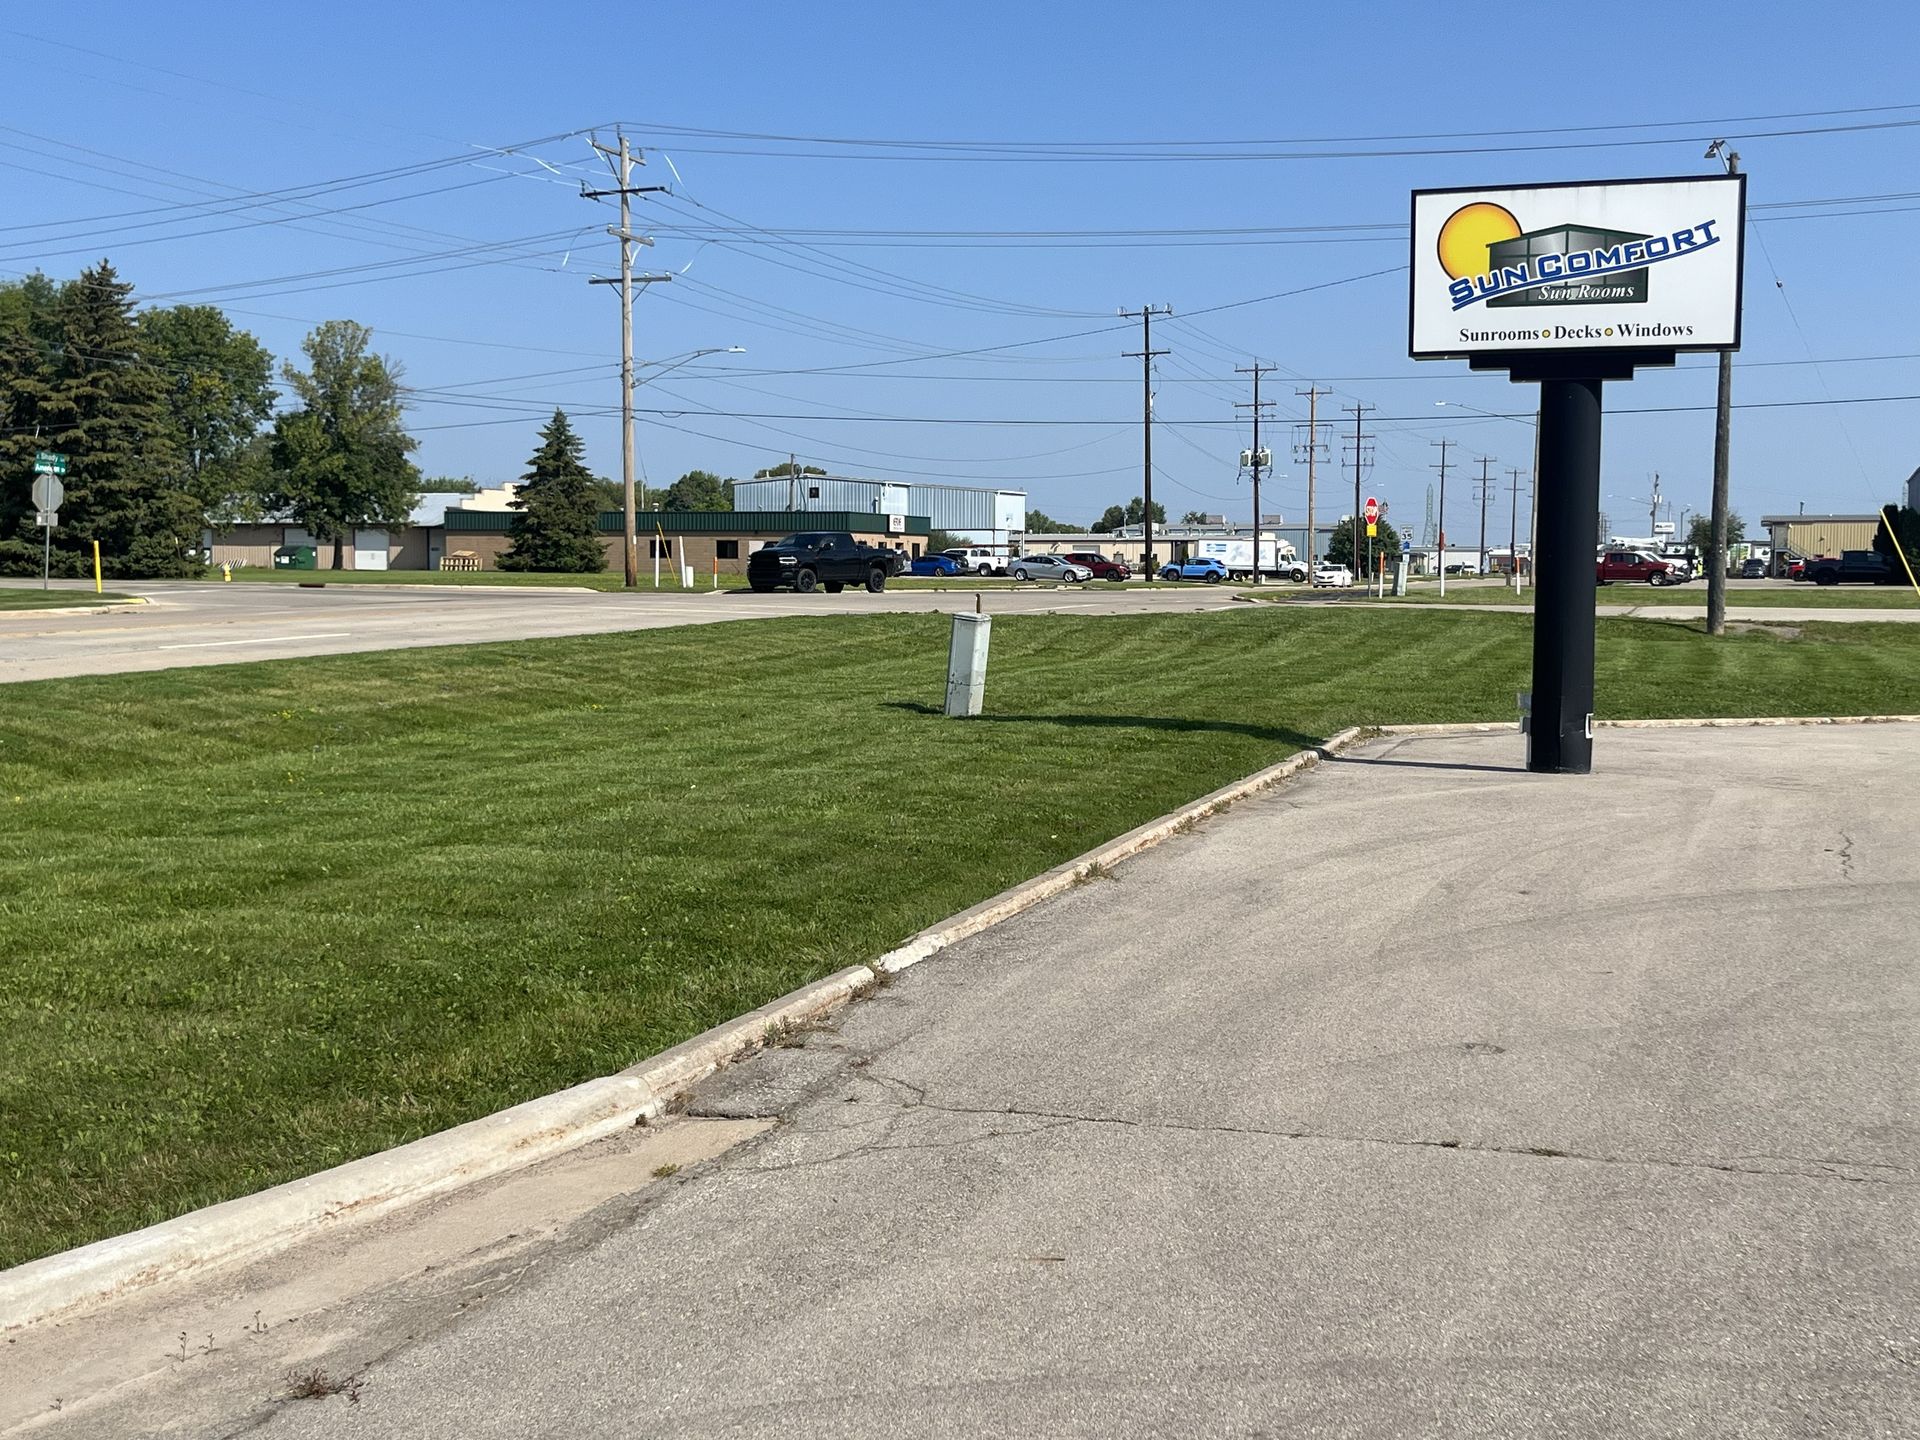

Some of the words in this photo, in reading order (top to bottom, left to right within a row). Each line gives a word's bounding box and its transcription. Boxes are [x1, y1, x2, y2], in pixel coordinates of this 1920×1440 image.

[1448, 265, 1529, 304] SUN
[1537, 219, 1717, 279] COMFORT
[1538, 285, 1571, 300] Sun
[1577, 284, 1635, 298] Rooms
[1459, 327, 1540, 343] Sunrooms
[1554, 324, 1602, 340] Decks
[1617, 323, 1694, 338] Windows
[1365, 505, 1378, 516] STOP
